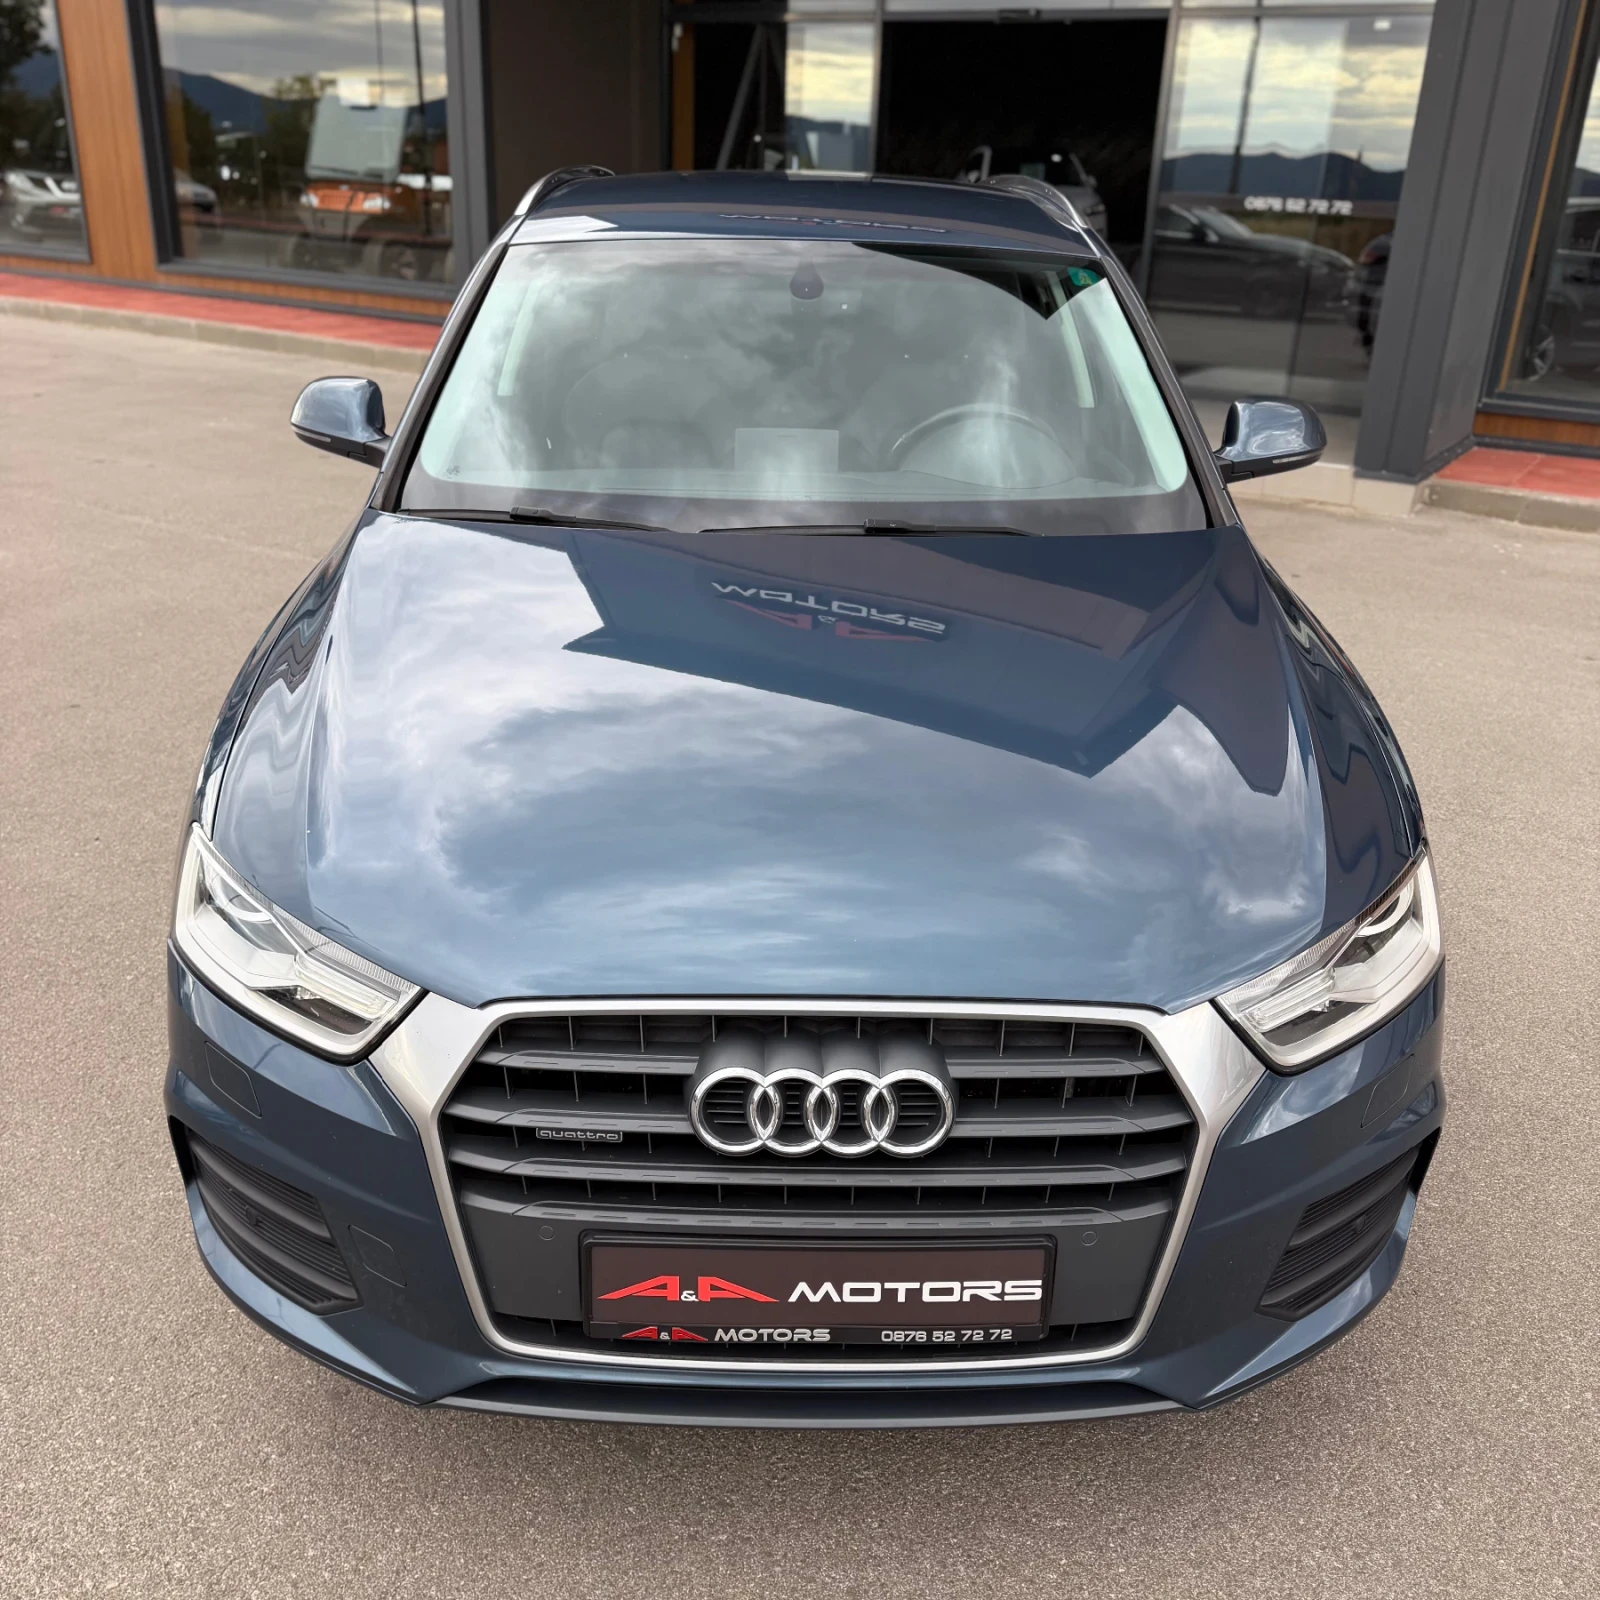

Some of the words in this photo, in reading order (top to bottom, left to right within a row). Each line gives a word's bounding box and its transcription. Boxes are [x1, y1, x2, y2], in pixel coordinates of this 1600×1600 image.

[540, 1130, 618, 1140] quattro
[597, 1275, 780, 1302] A&A
[788, 1280, 1042, 1302] MOTORS
[621, 1326, 708, 1342] A&A
[714, 1328, 831, 1342] MOTORS
[881, 1330, 927, 1342] 0876
[932, 1330, 956, 1342] 52
[961, 1329, 985, 1341] 72
[989, 1329, 1013, 1340] 72
